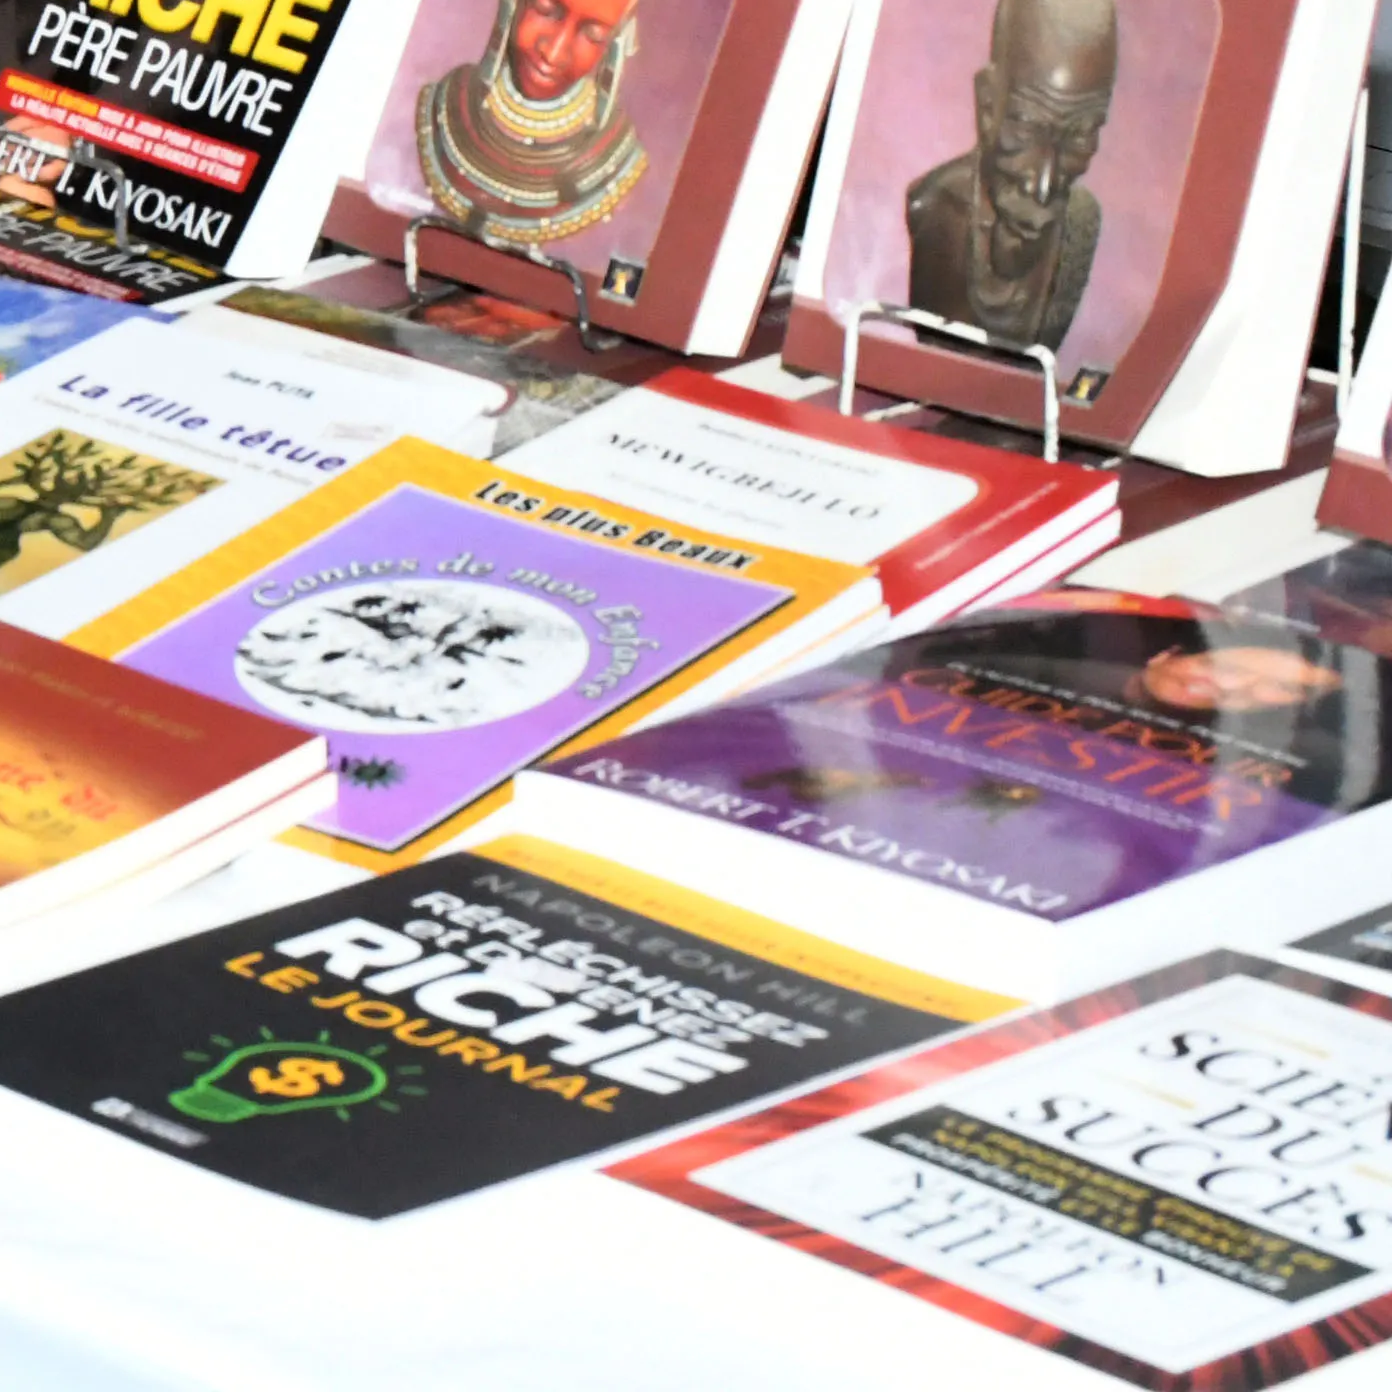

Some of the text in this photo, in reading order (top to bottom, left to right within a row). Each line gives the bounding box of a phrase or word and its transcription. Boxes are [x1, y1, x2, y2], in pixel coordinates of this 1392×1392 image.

[27, 2, 292, 137] PÈRE PAUVRE
[22, 232, 200, 293] PAUVRE
[57, 373, 349, 473] La fille têtue
[250, 552, 420, 612] Contes
[433, 550, 494, 581] de
[505, 561, 600, 611] mon
[472, 479, 540, 516] Les
[538, 502, 624, 543] plus
[632, 525, 759, 574] Beaux
[573, 757, 777, 822] ROBERT
[818, 823, 1071, 913] KIYOSAKI
[273, 918, 751, 1098] RICHE
[405, 918, 461, 948] et
[463, 938, 764, 1053] DENEZ
[408, 890, 833, 1049] RÉFLÉCHISSEZ
[472, 872, 774, 986] NAPOLEON
[767, 970, 869, 1028] HILL
[224, 952, 629, 1114] LE JOURNAL
[1006, 1096, 1392, 1242] SUCCÈS
[1191, 1101, 1366, 1168] DU
